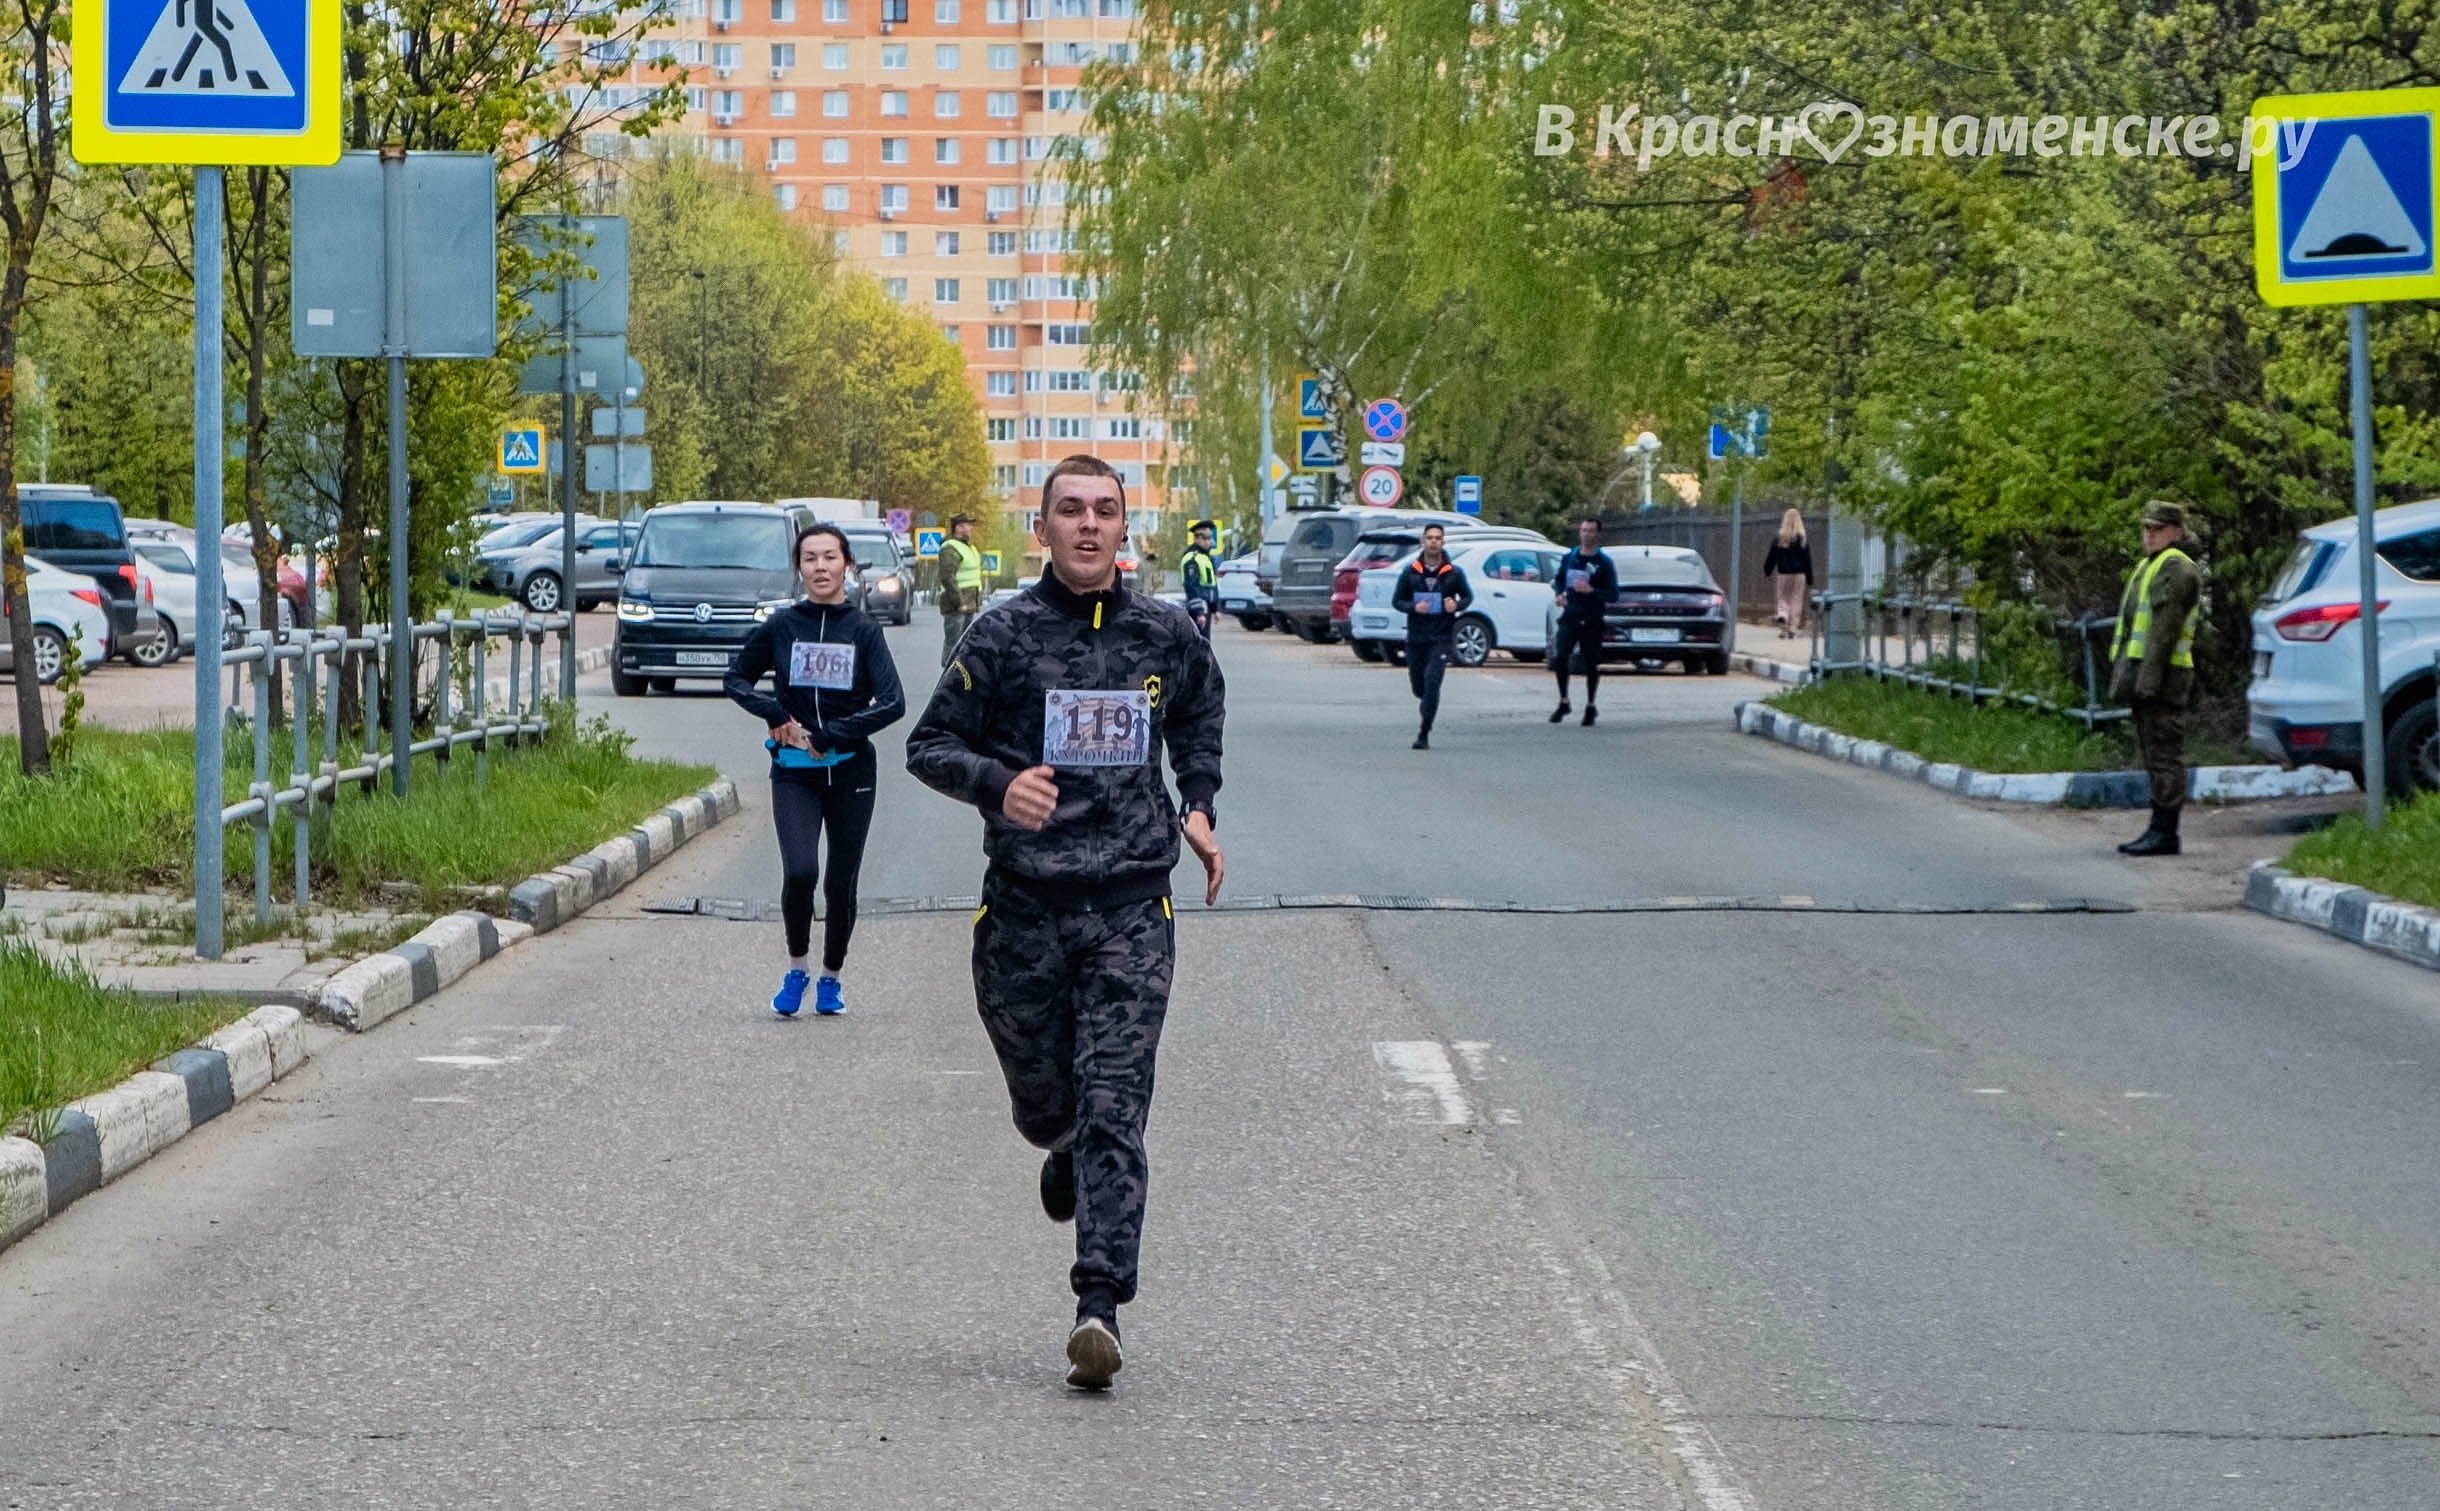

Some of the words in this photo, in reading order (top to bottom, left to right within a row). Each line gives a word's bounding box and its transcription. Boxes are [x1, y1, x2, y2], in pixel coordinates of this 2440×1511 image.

[1371, 478, 1393, 495] 20
[803, 652, 842, 673] 106
[1067, 704, 1133, 741] 119
